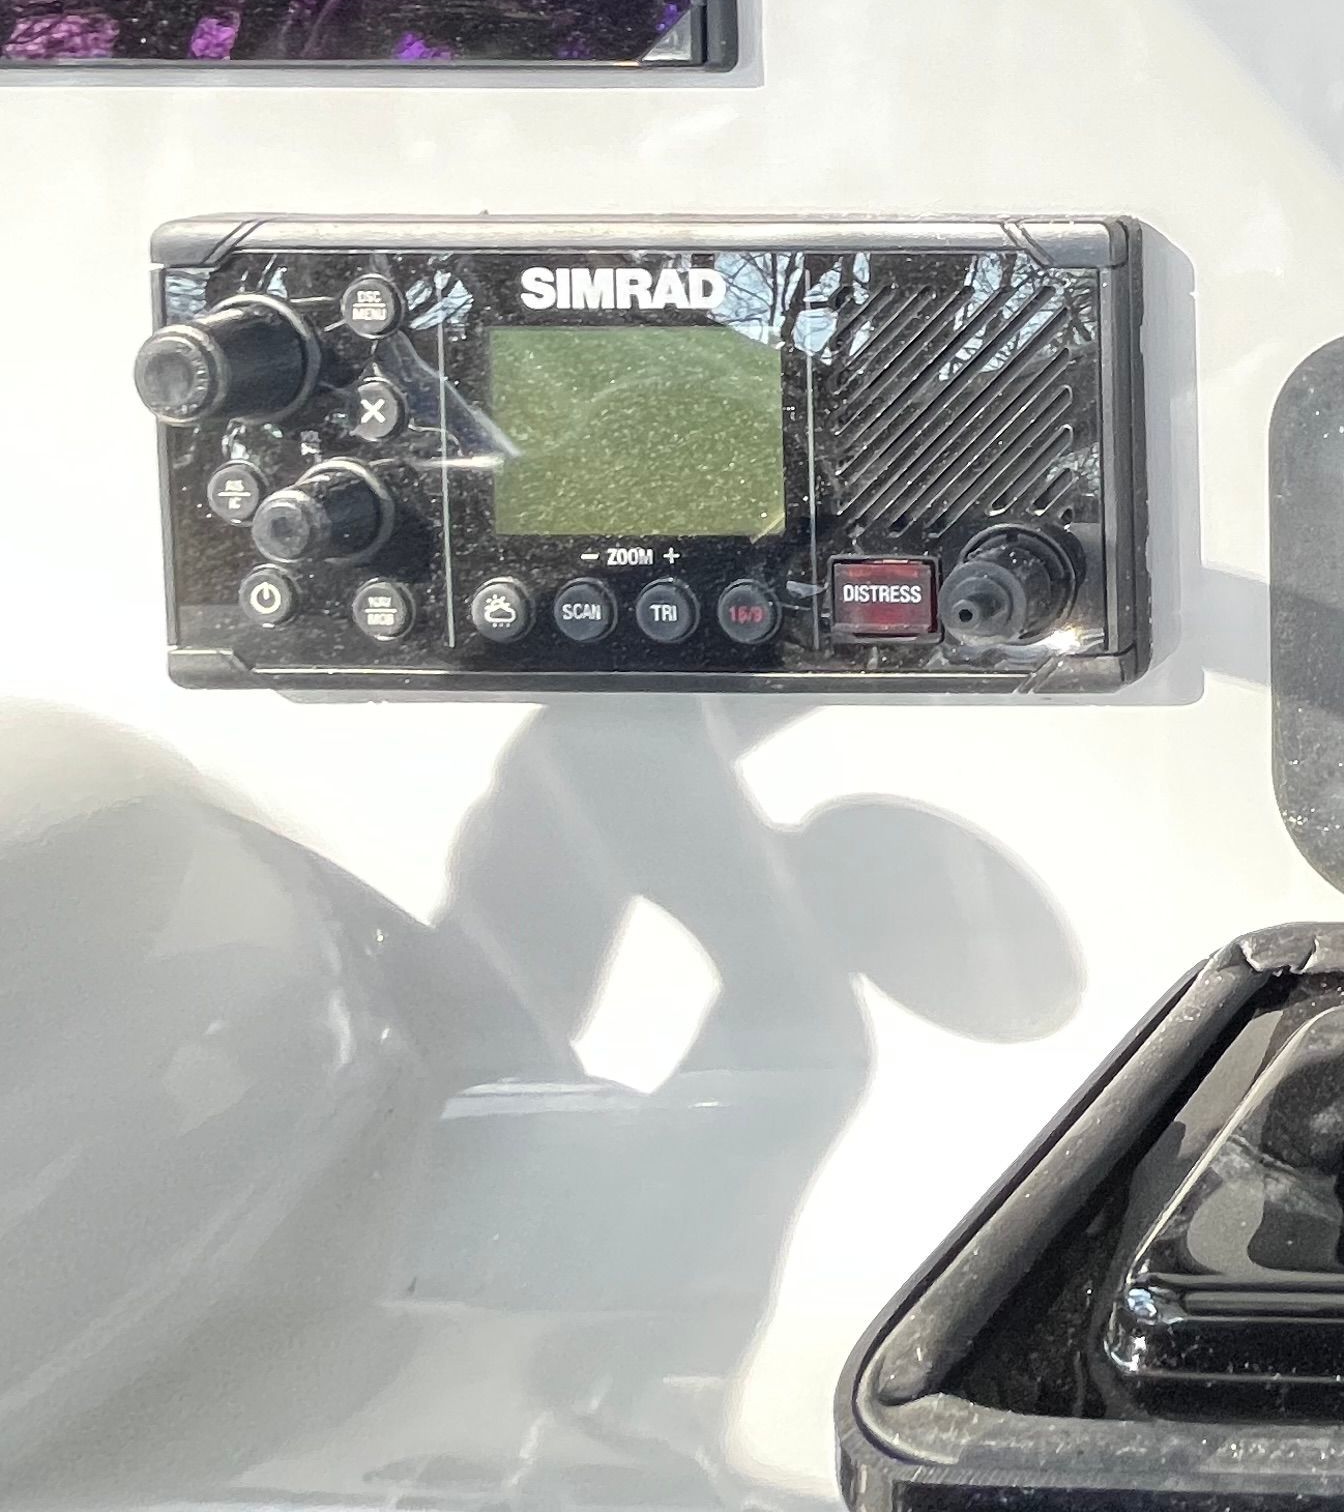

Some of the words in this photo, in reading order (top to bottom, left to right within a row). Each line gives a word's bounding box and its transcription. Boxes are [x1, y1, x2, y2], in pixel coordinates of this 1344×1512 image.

[520, 267, 727, 309] SIMRAD
[352, 308, 387, 321] MENU
[607, 548, 654, 566] ZOOM
[842, 584, 922, 604] DISTRESS
[562, 603, 602, 621] SCAN
[650, 604, 678, 622] TRI
